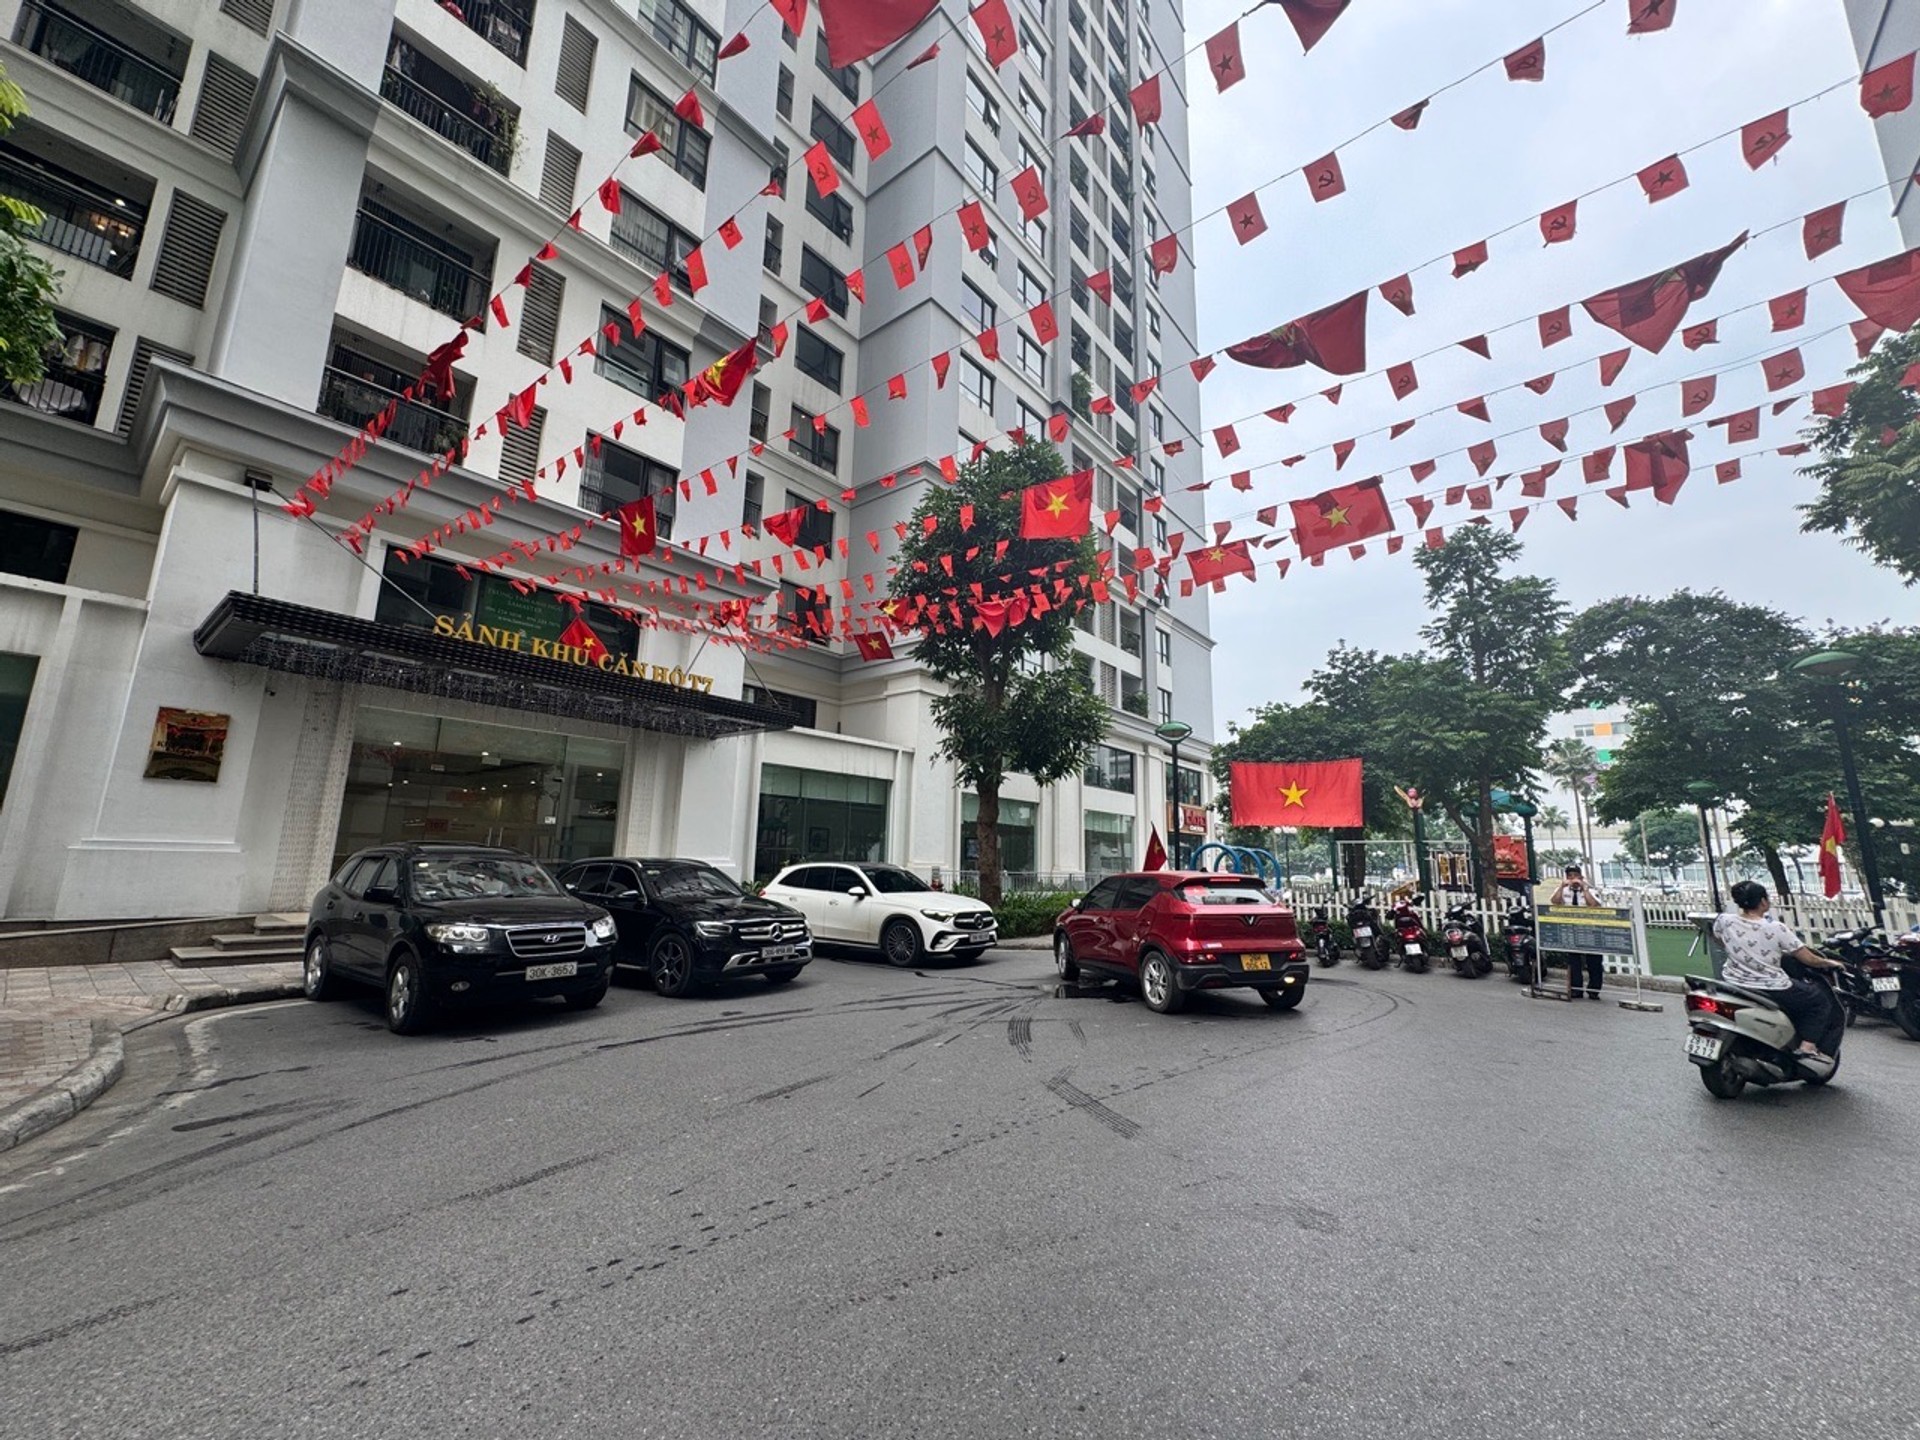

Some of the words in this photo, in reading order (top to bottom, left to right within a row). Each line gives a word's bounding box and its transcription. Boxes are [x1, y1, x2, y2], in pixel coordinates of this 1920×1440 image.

[432, 612, 522, 653] SẢNH
[531, 637, 591, 666] KHU
[598, 652, 648, 680] CĂN
[652, 665, 688, 692] HỘ
[689, 673, 715, 694] T7
